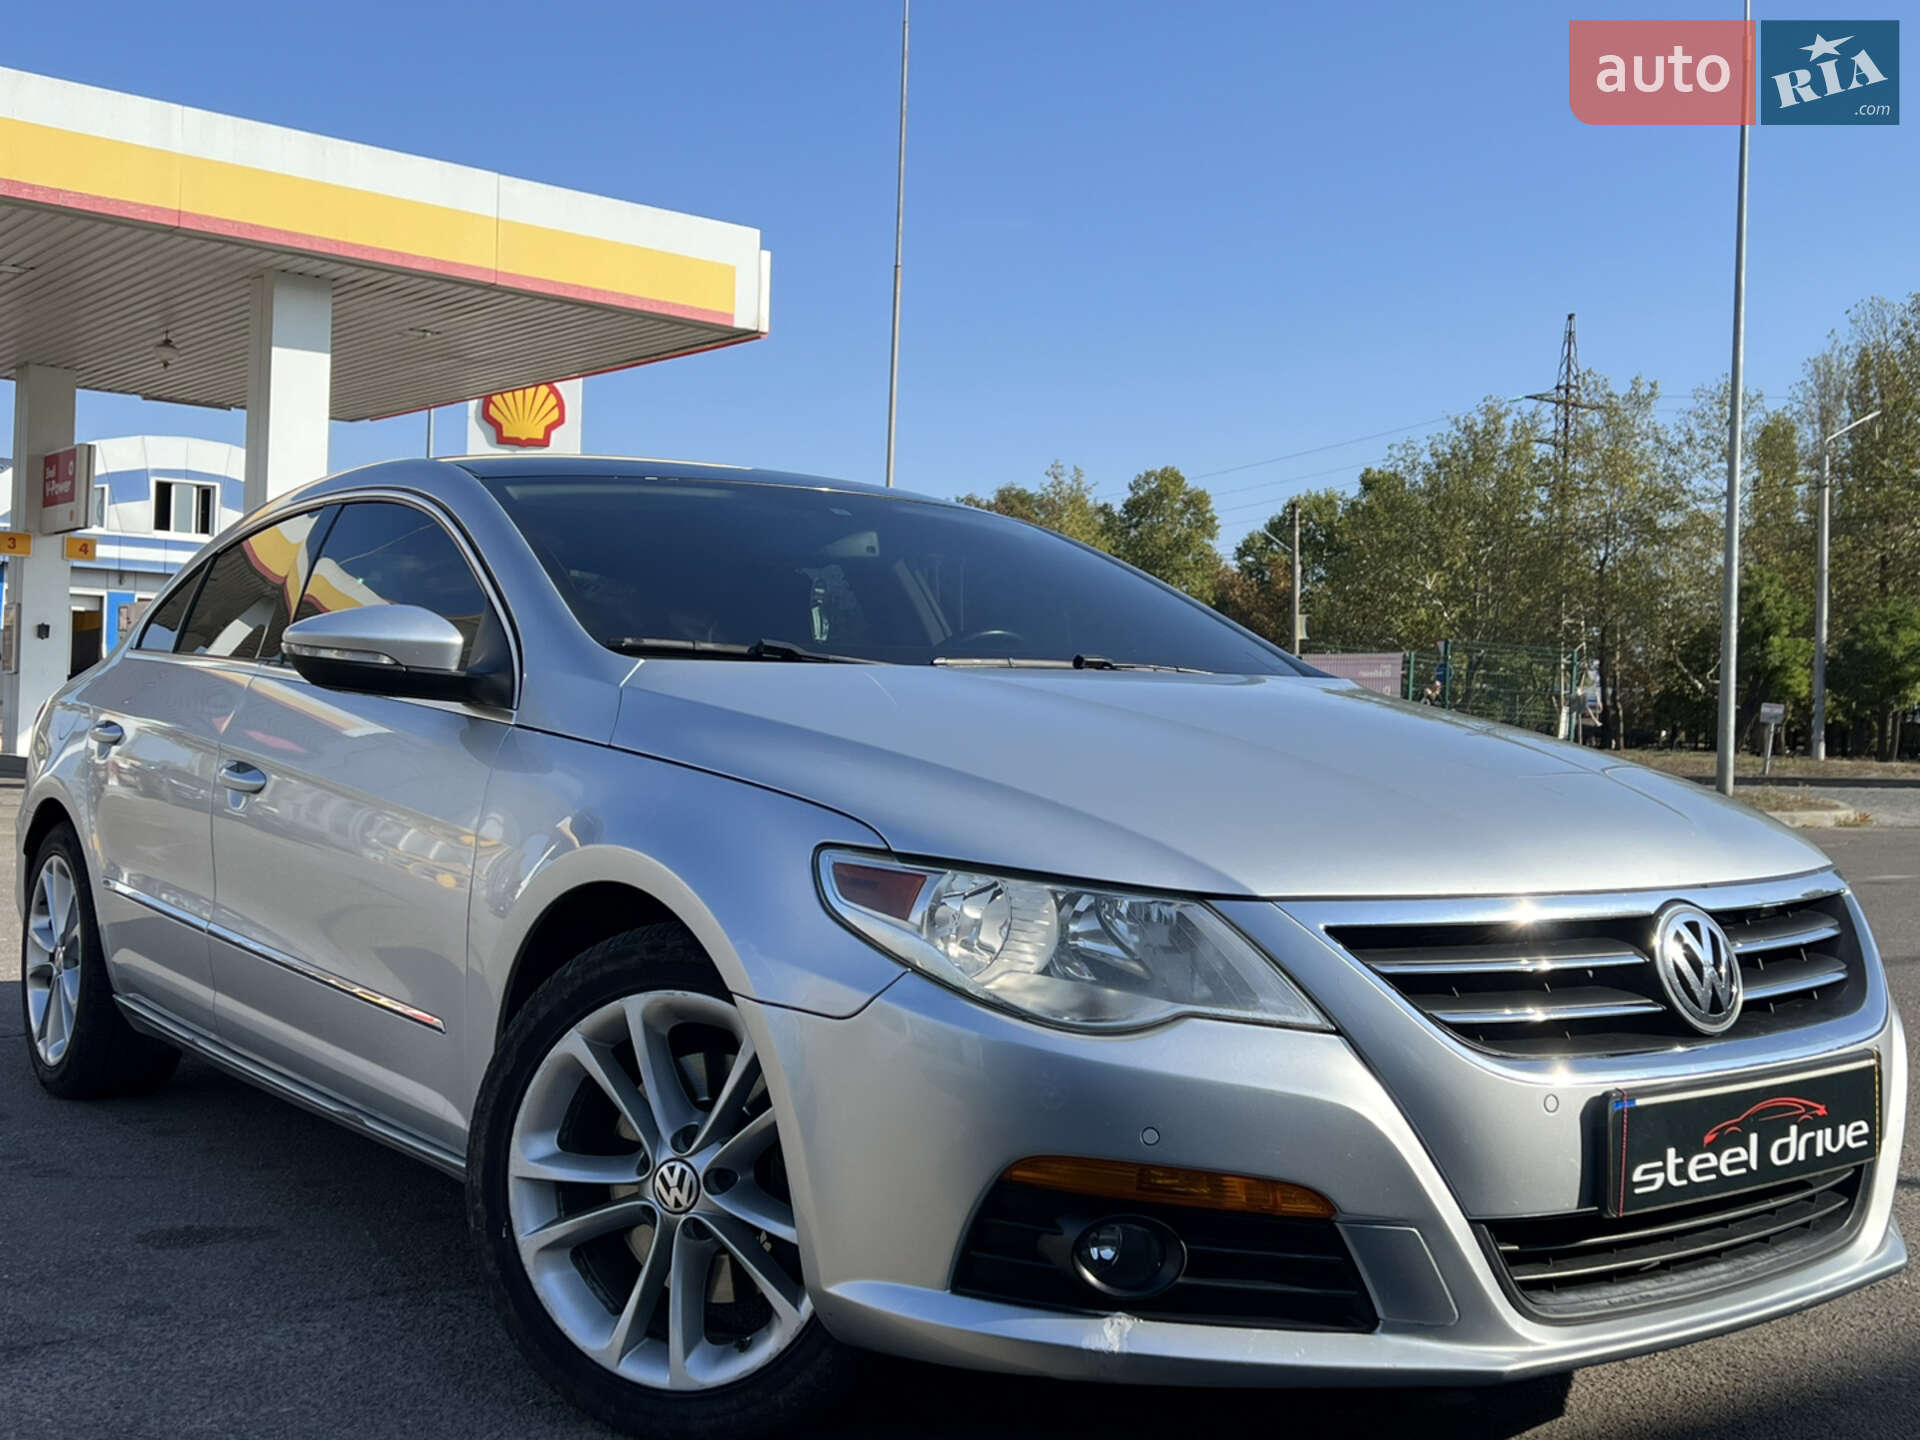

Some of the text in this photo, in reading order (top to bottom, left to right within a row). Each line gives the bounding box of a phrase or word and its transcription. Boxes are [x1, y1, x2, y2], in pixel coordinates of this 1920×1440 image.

[7, 537, 17, 549] 3
[79, 543, 89, 555] 4
[1632, 1119, 1869, 1194] steel drive
